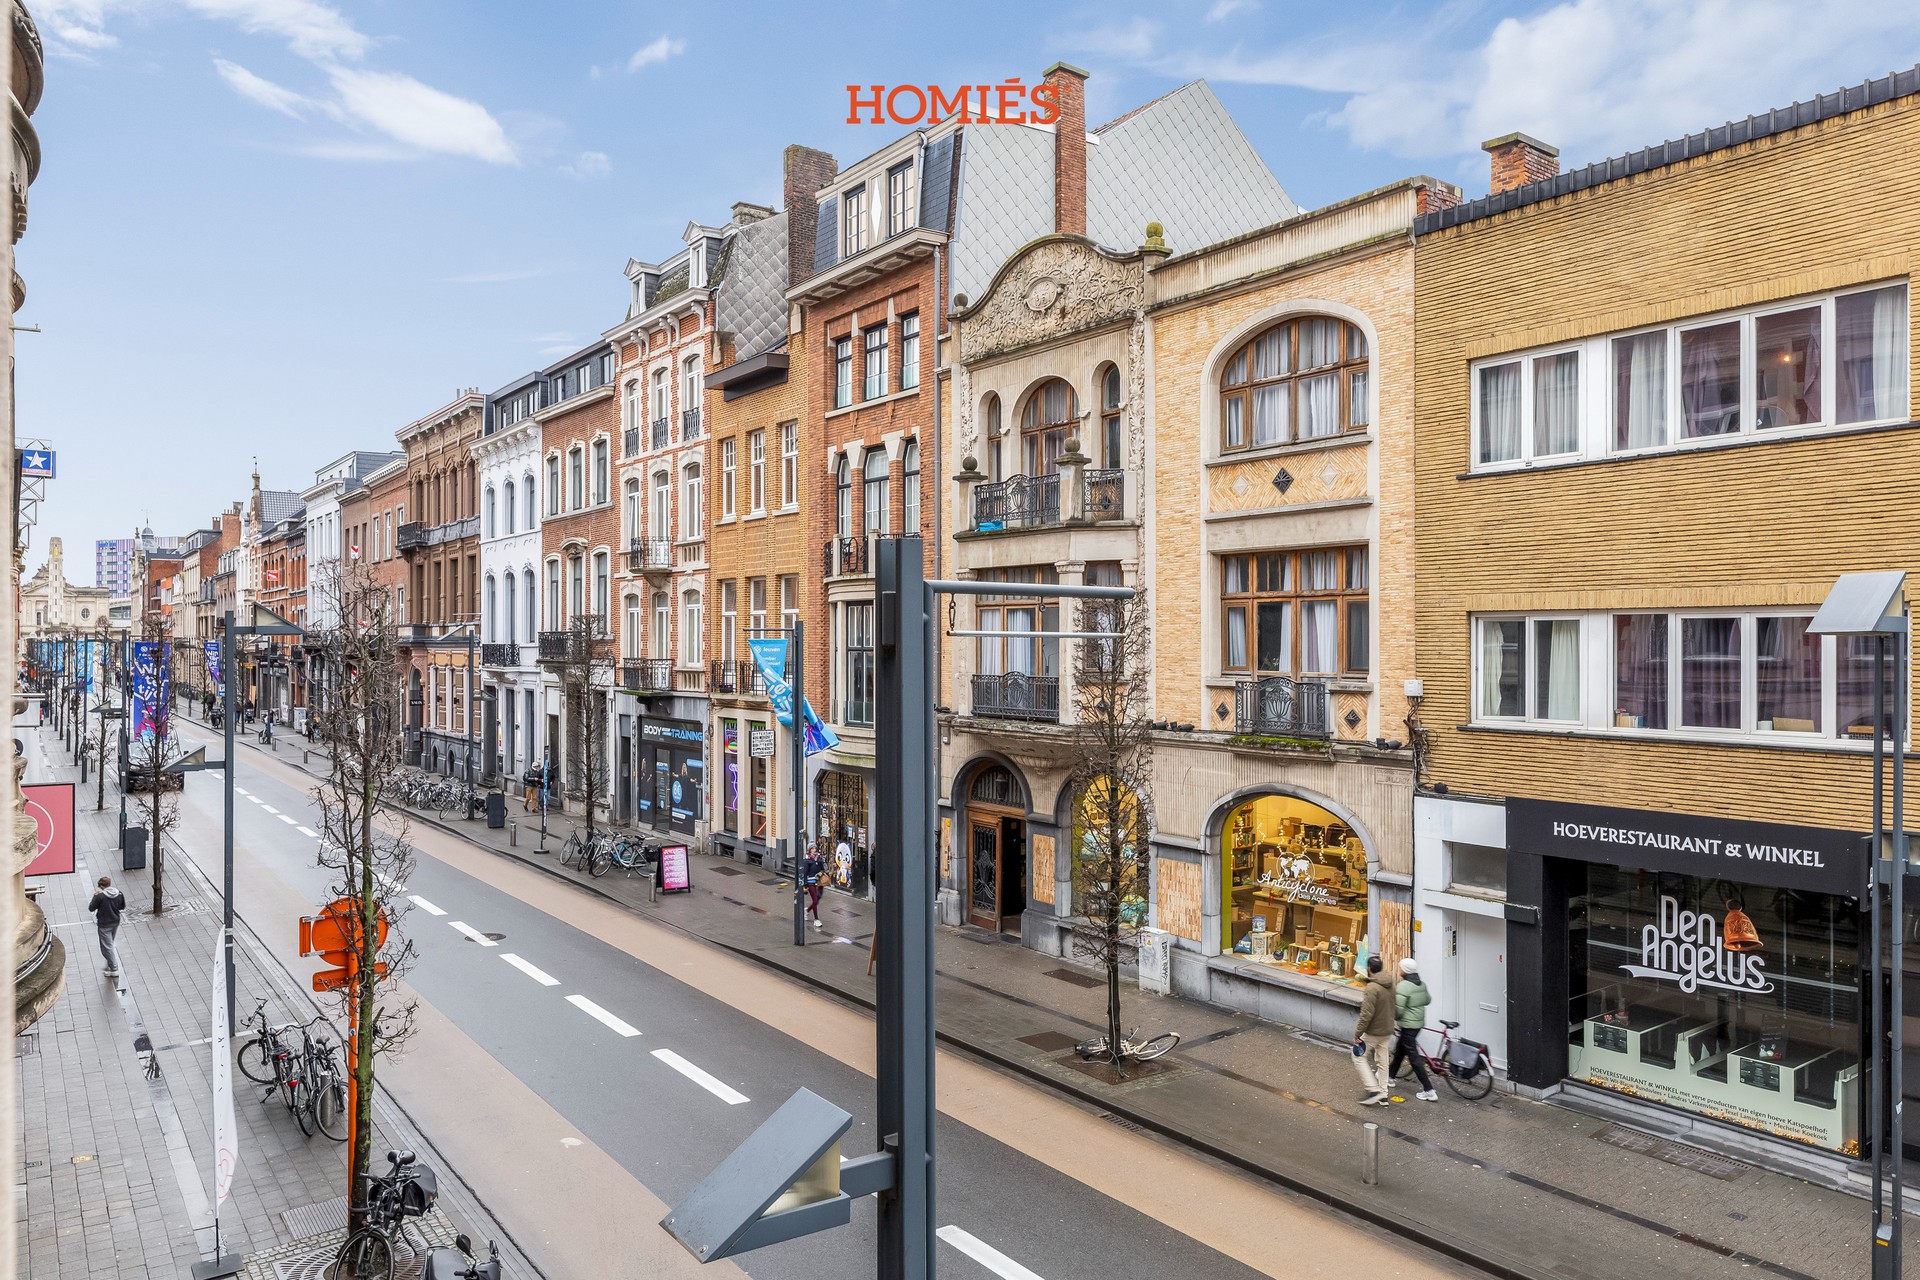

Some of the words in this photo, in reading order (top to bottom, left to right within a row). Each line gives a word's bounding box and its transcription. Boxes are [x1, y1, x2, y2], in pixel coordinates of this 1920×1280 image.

[643, 724, 662, 736] BODY
[671, 728, 703, 741] TRAINING
[1553, 821, 1722, 855] HOEVERESTAURANT
[1725, 843, 1742, 858] &
[1745, 843, 1825, 868] WINKEL
[1257, 869, 1330, 903] Anticyclone
[1661, 894, 1716, 947] Den
[1642, 924, 1766, 994] Angelus
[1590, 1066, 1647, 1086] HOEVERESTAURANT
[1655, 1083, 1679, 1095] WINKEL
[1706, 1098, 1737, 1110] producten
[1750, 1109, 1766, 1118] eigen
[1767, 1113, 1786, 1123] hoeve
[1667, 1093, 1687, 1103] Landras
[1725, 1108, 1739, 1117] Texel
[1773, 1122, 1800, 1134] Mechelse
[1801, 1130, 1828, 1141] Koekoek
